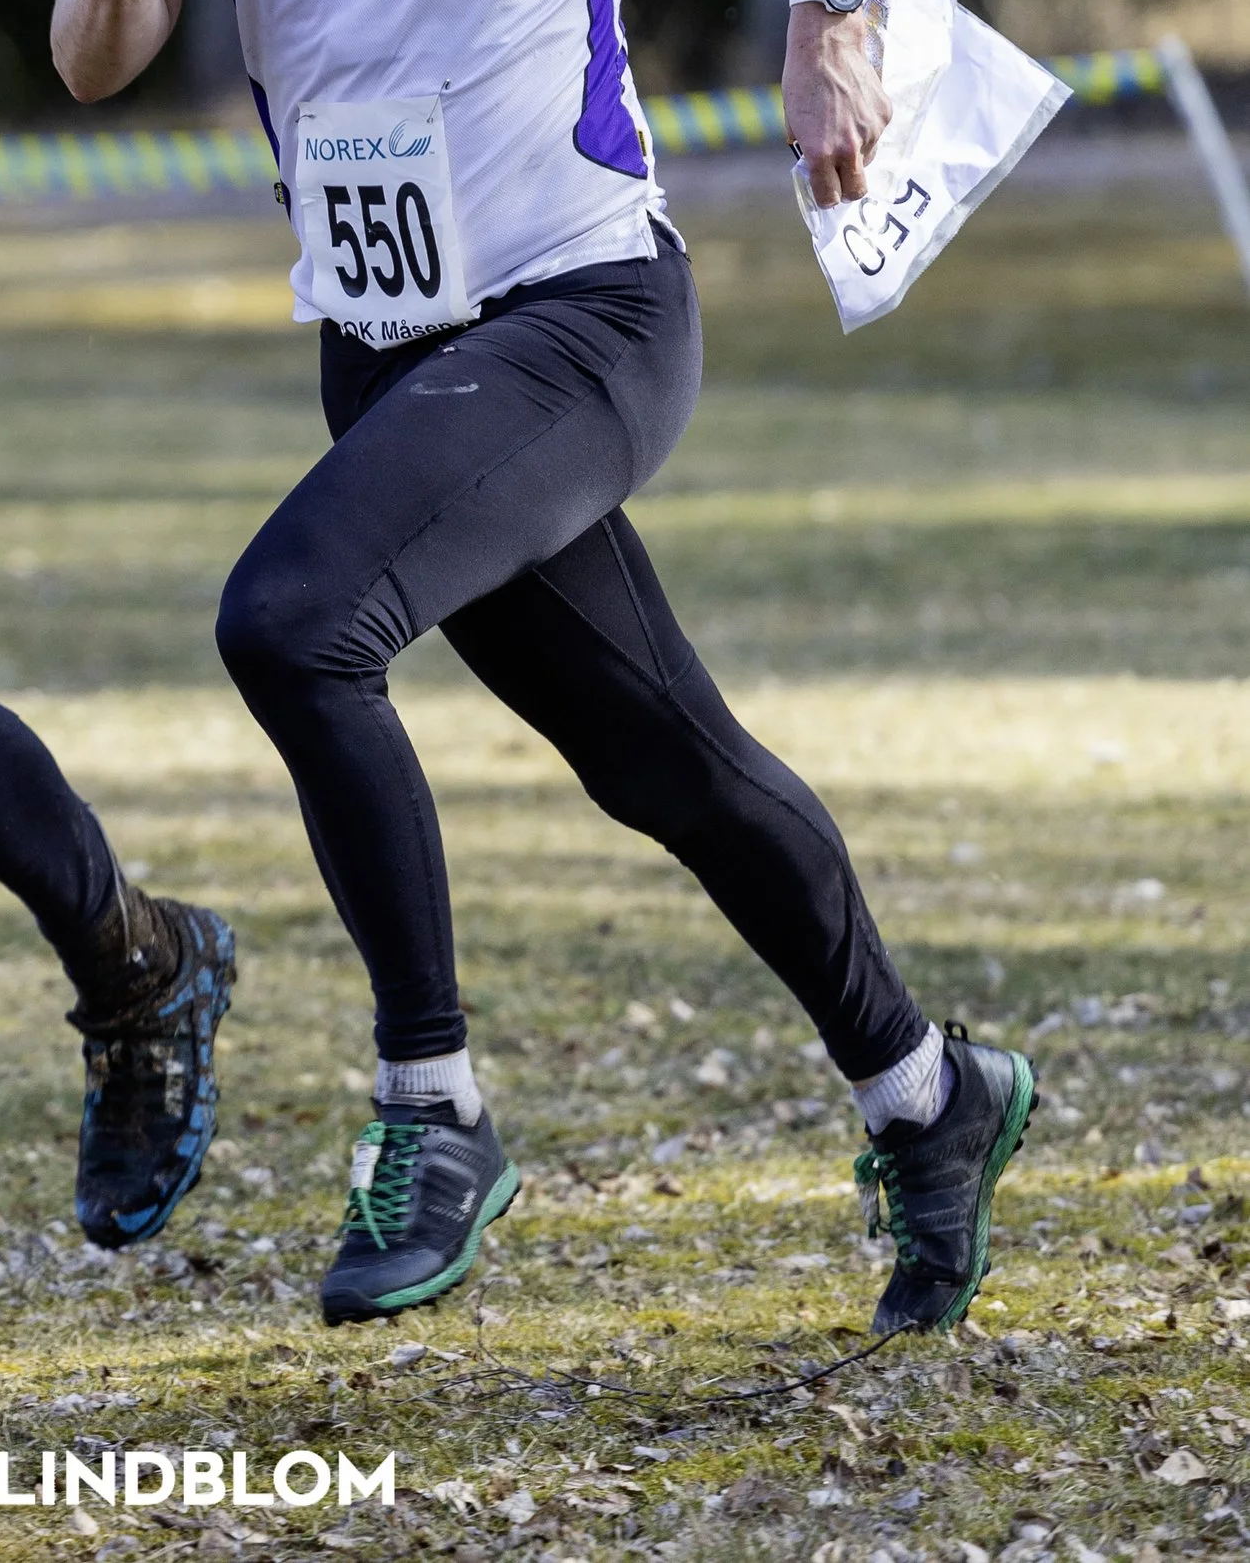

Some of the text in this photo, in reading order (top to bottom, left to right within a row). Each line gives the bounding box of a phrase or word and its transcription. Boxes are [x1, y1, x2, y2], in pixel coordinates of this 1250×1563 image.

[305, 137, 388, 162] NOREX
[323, 181, 442, 300] 550
[343, 319, 452, 341] OK Måsen
